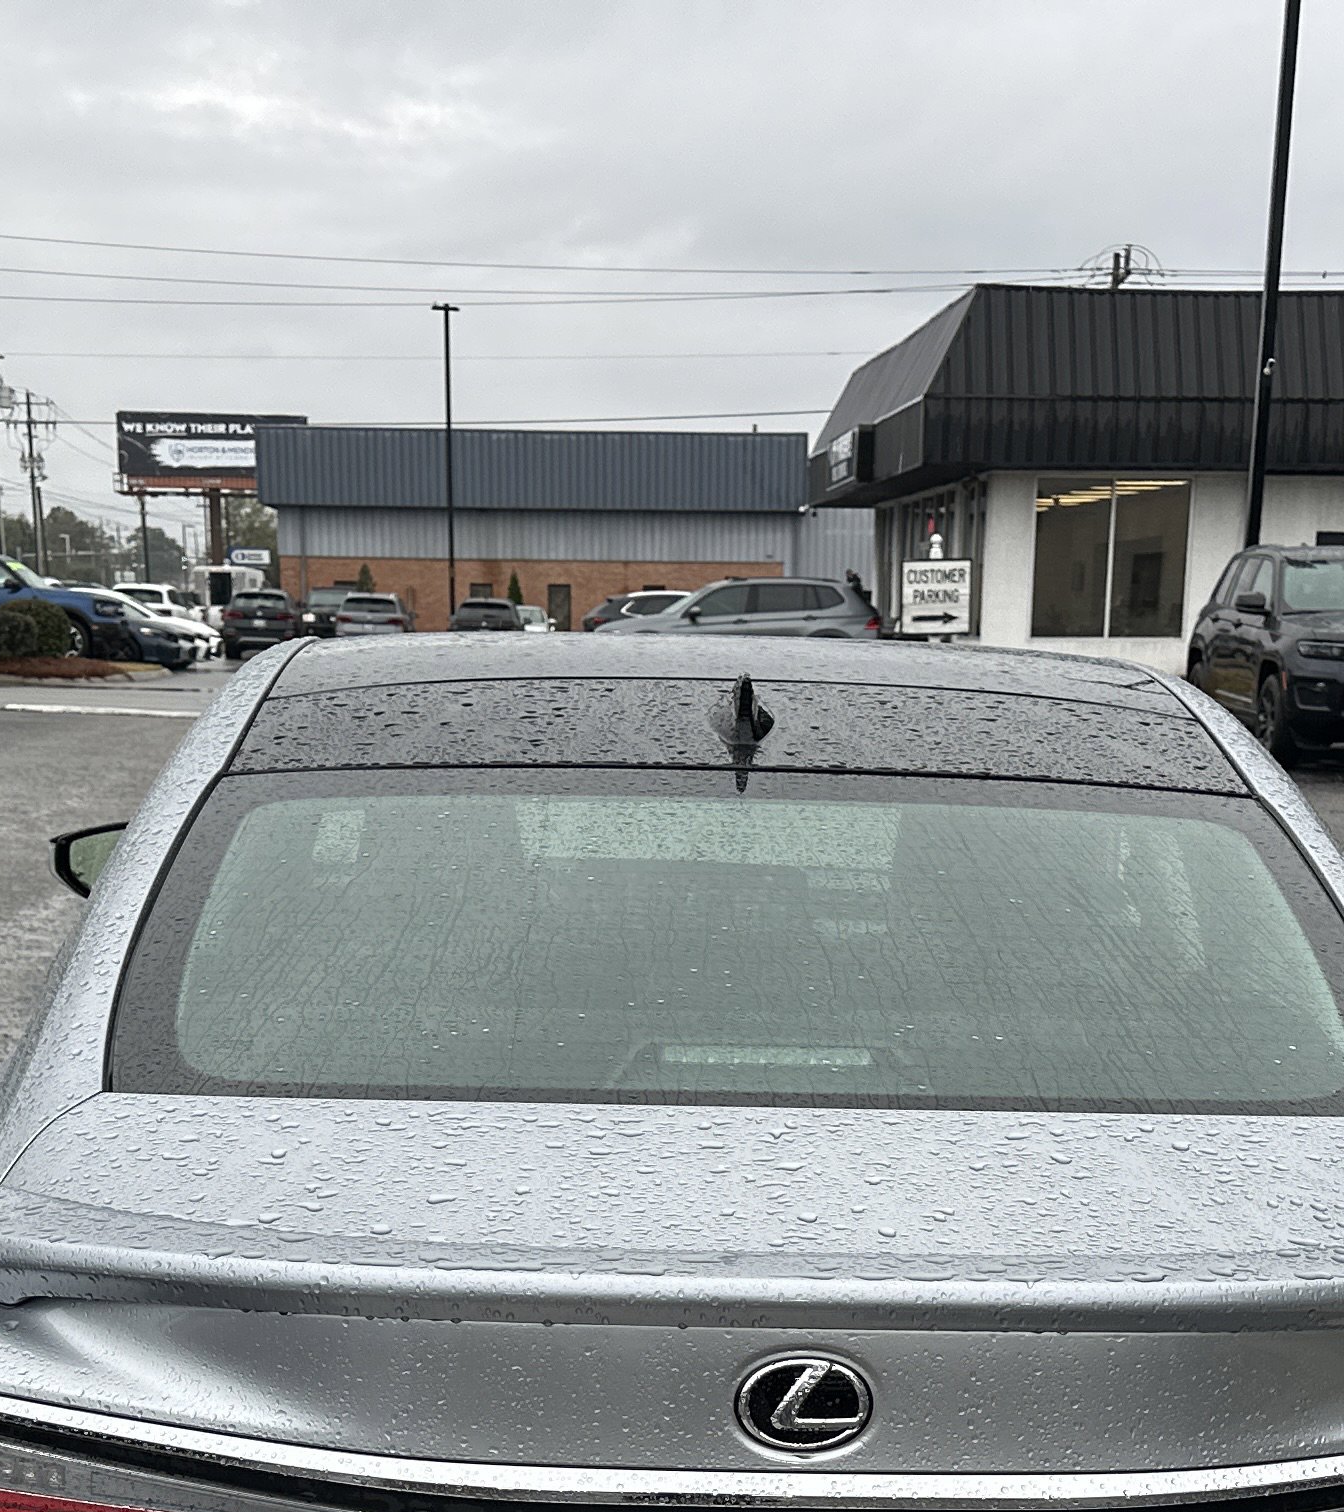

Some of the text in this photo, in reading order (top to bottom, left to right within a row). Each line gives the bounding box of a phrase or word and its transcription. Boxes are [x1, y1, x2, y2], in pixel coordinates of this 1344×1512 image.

[121, 421, 143, 433] WE
[145, 422, 187, 433] KNOW
[189, 423, 227, 434] THEIR
[907, 568, 967, 584] CUSTOMER
[912, 588, 960, 605] PARKING
